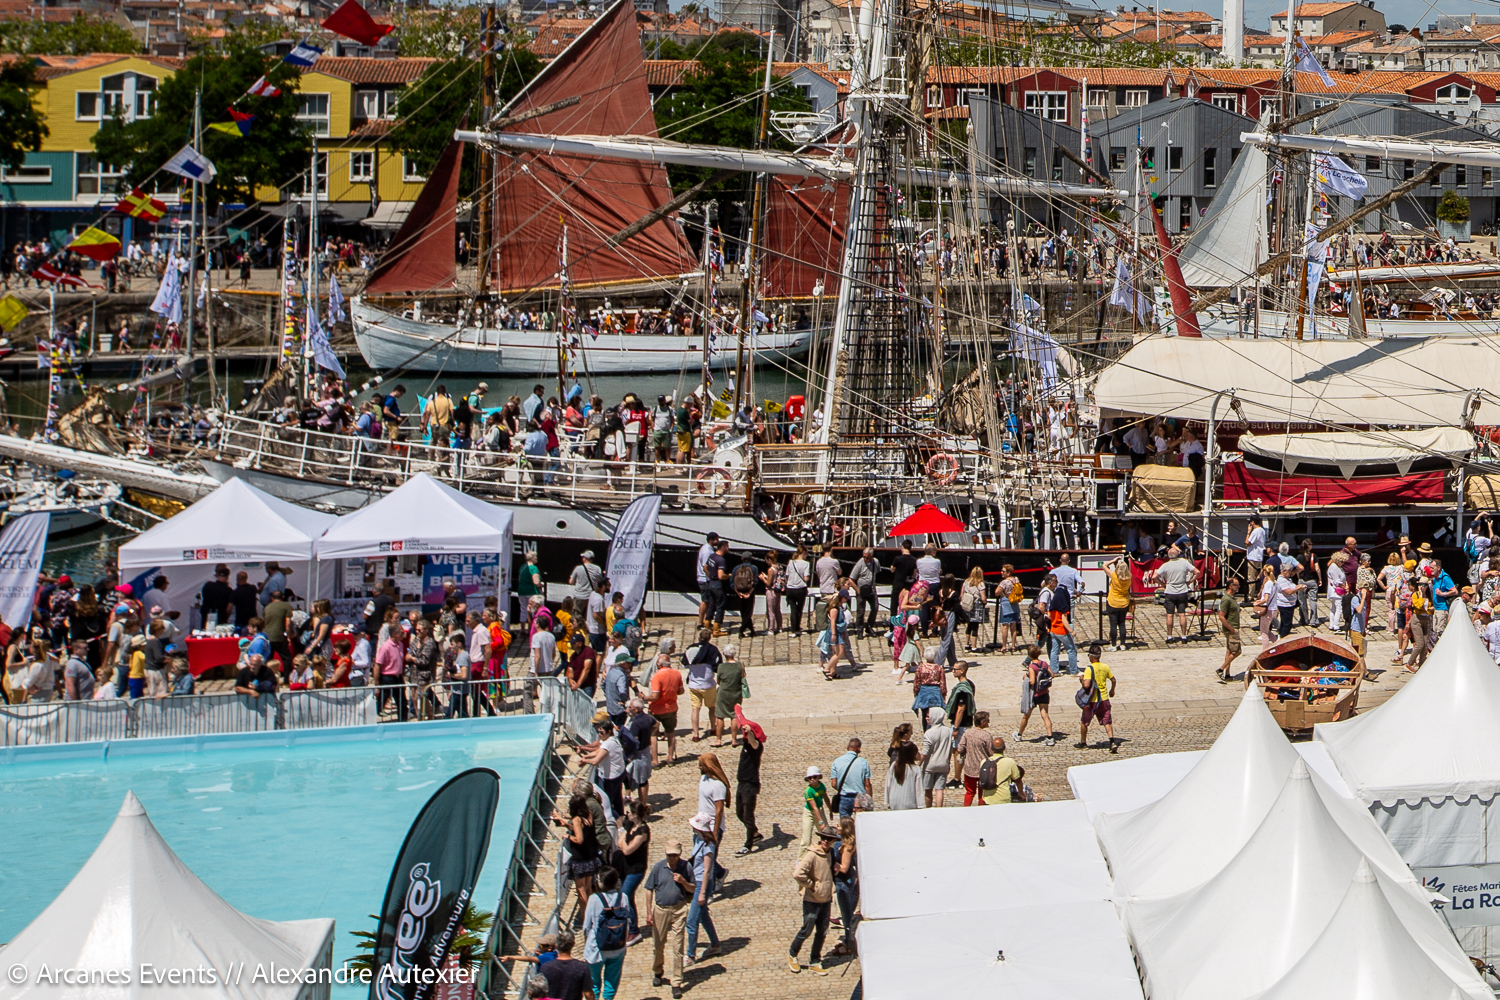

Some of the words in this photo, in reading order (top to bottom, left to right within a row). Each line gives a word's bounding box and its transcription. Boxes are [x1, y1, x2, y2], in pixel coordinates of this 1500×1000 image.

[615, 536, 652, 550] BELEM
[431, 554, 496, 565] VISITEZ
[453, 565, 473, 575] LE
[1452, 884, 1478, 893] Fêtes
[1452, 896, 1474, 910] La
